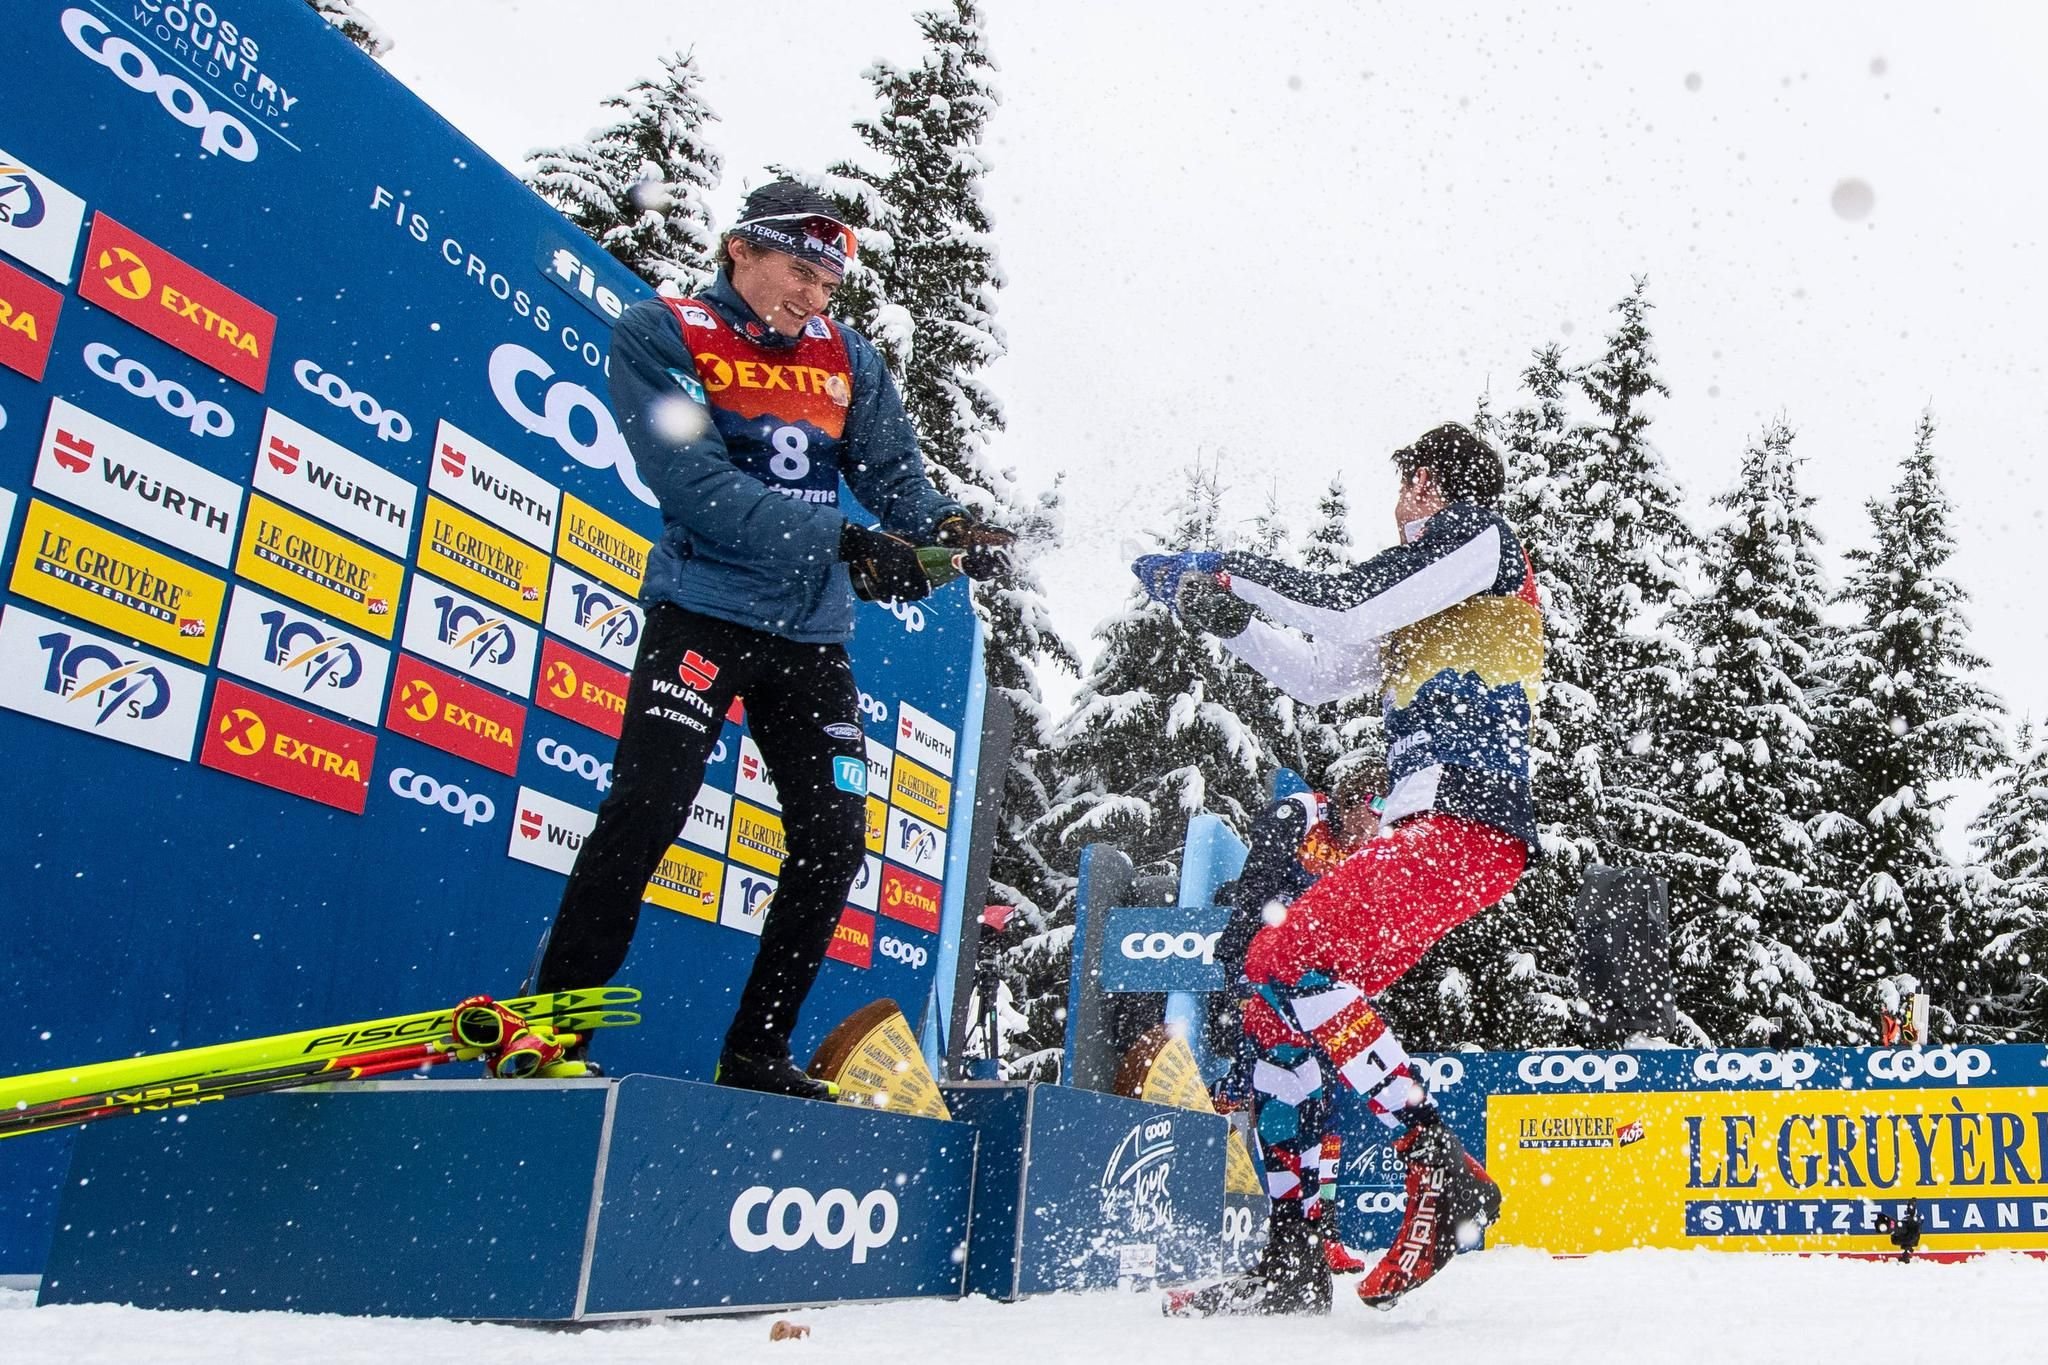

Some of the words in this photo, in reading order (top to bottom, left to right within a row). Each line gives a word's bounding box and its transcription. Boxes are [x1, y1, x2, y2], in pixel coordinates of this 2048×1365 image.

[183, 0, 259, 62] OSS
[61, 8, 259, 162] coop
[133, 5, 220, 78] WORLD
[233, 82, 279, 117] CUP
[372, 185, 429, 242] FIS
[442, 238, 551, 331] CROSS
[753, 224, 797, 245] TERREX
[553, 249, 630, 319] fie
[160, 285, 259, 358] EXTRA
[83, 342, 235, 438] coop
[294, 359, 413, 443] coop
[488, 343, 660, 508] co
[769, 425, 810, 480] 8
[103, 457, 229, 534] WÜRTH
[306, 460, 407, 529] WÜRTH
[471, 465, 552, 526] WÜRTH
[257, 520, 282, 547] LE
[285, 535, 371, 591] GRUYÈRE
[433, 519, 453, 542] LE
[455, 531, 524, 581] GRUYÈRE
[434, 543, 518, 589] SWITZERLAND
[569, 514, 586, 536] LE
[587, 525, 643, 570] GRUYÈRE
[570, 535, 638, 578] SWITZERLAND
[38, 530, 72, 564] LE
[75, 546, 184, 611] GRUYÈRE
[41, 562, 171, 621] SWITZERLAND
[258, 548, 361, 601] SWITZERLAND
[434, 595, 516, 665] 100
[572, 584, 639, 647] 100
[260, 610, 362, 689] 100
[38, 632, 171, 719] 100
[581, 682, 627, 716] EXTR
[652, 679, 714, 717] WÜRTH
[443, 703, 513, 748] EXTRA
[663, 707, 708, 733] TERREX
[857, 689, 888, 723] op
[273, 733, 361, 782] EXTRA
[914, 728, 952, 759] WÜRTH
[839, 761, 863, 791] TQ
[866, 758, 888, 780] RTH
[898, 769, 907, 785] LE
[907, 774, 938, 802] GRUYÈRE
[389, 767, 496, 827] coop
[693, 804, 725, 830] RTH
[739, 817, 750, 836] LE
[752, 823, 786, 850] GRUYÈ
[650, 875, 699, 896] ITZERLAND
[740, 876, 777, 915] 10
[904, 891, 937, 914] EXTRA
[879, 936, 928, 970] coop
[303, 1001, 537, 1054] FISCHR
[1366, 1050, 1387, 1072] 1
[1517, 1054, 1639, 1091] coop
[1693, 1051, 1818, 1088] coop
[1868, 1048, 1991, 1085] coop
[1144, 1120, 1171, 1141] coop
[1520, 1118, 1538, 1138] LE
[1541, 1114, 1614, 1137] GRUYÈRE
[1523, 1139, 1612, 1147] SWITZERLAND
[1381, 1172, 1406, 1180] WOR
[1684, 1116, 1759, 1189] LE
[729, 1186, 898, 1264] coop
[1357, 1192, 1407, 1212] co
